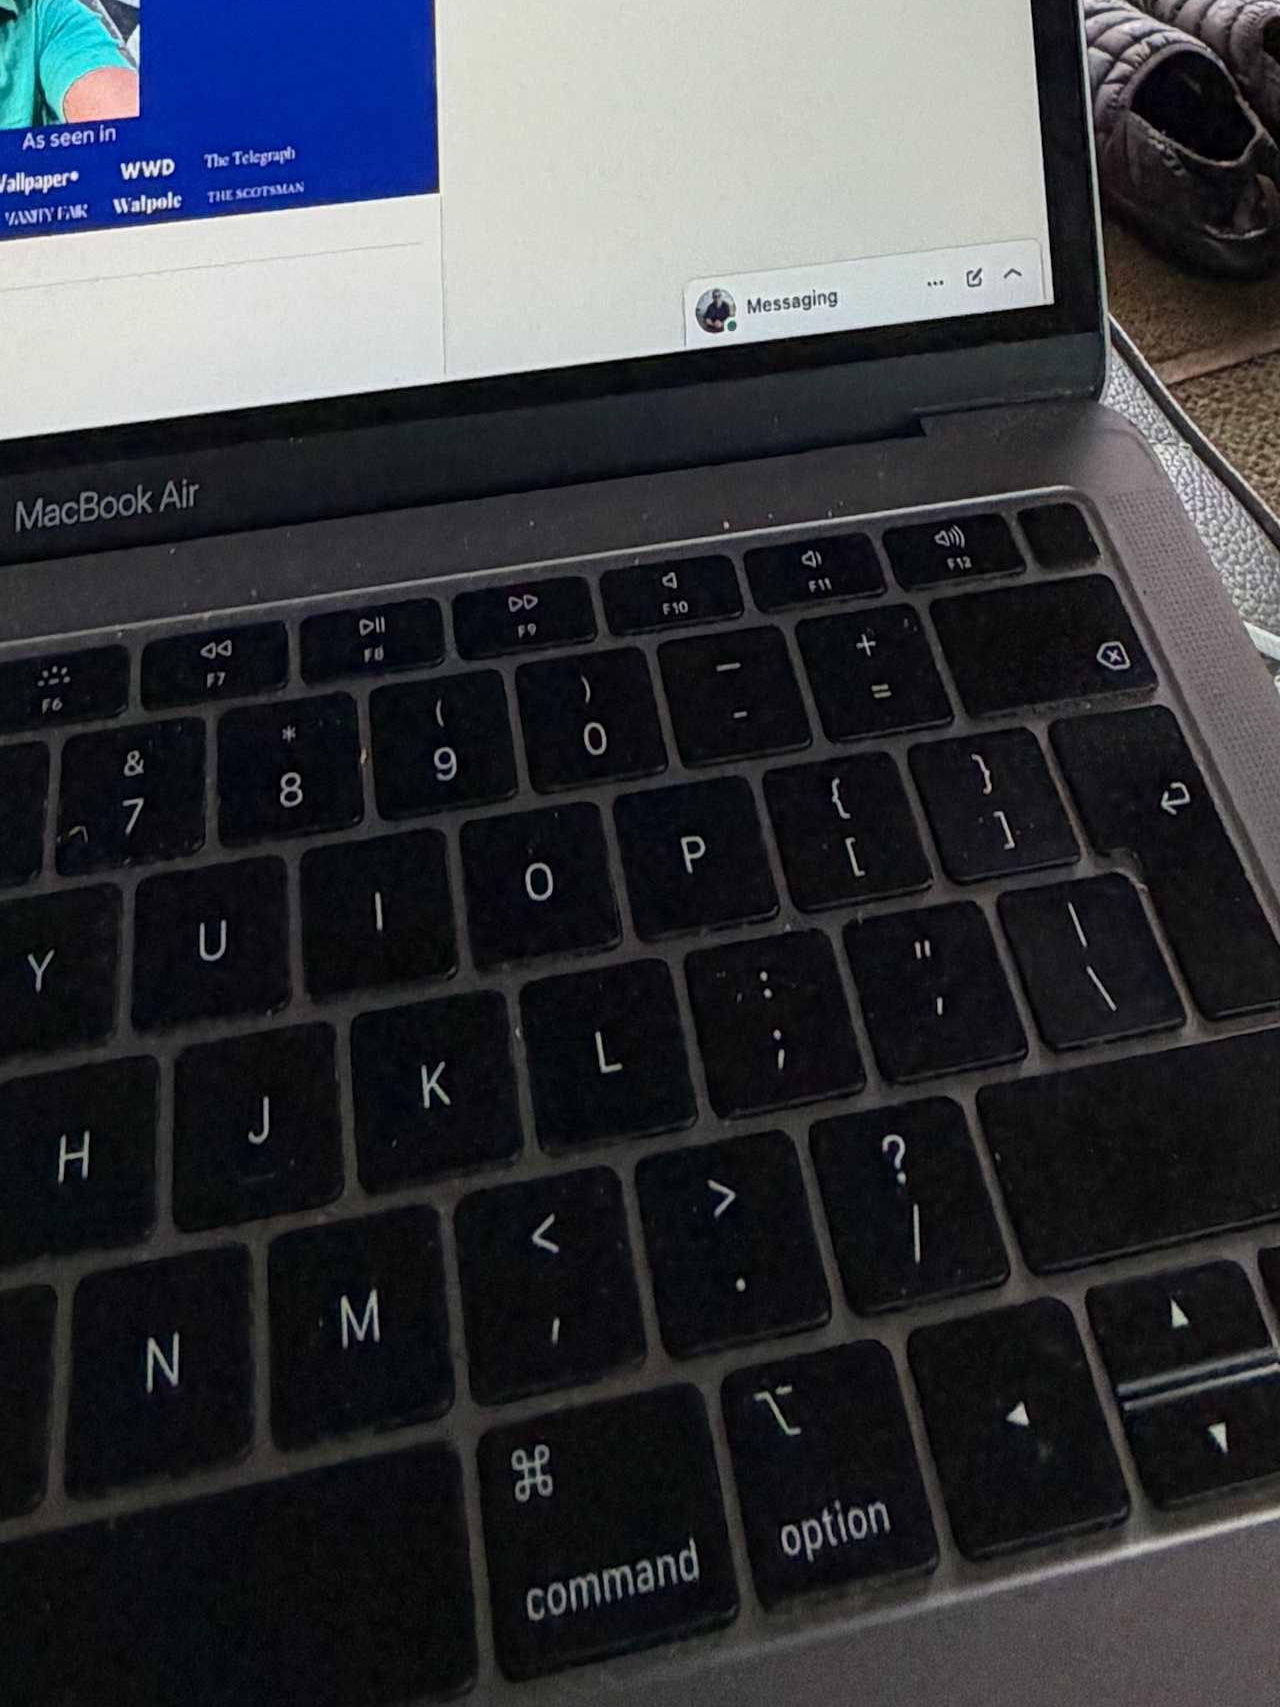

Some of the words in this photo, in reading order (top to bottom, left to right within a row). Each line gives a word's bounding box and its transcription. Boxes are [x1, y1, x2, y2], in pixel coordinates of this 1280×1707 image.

[22, 130, 46, 151] As
[49, 128, 96, 148] seen
[99, 124, 118, 144] in
[120, 158, 176, 181] WWD
[204, 150, 230, 170] The
[232, 145, 297, 169] Telegraph
[113, 191, 184, 217] Walpole
[746, 288, 839, 317] Messaging
[15, 486, 154, 534] MacBook
[159, 479, 201, 513] Air
[421, 1061, 451, 1109] K
[340, 1288, 381, 1350] M
[780, 1498, 891, 1561] option
[527, 1538, 701, 1623] command
